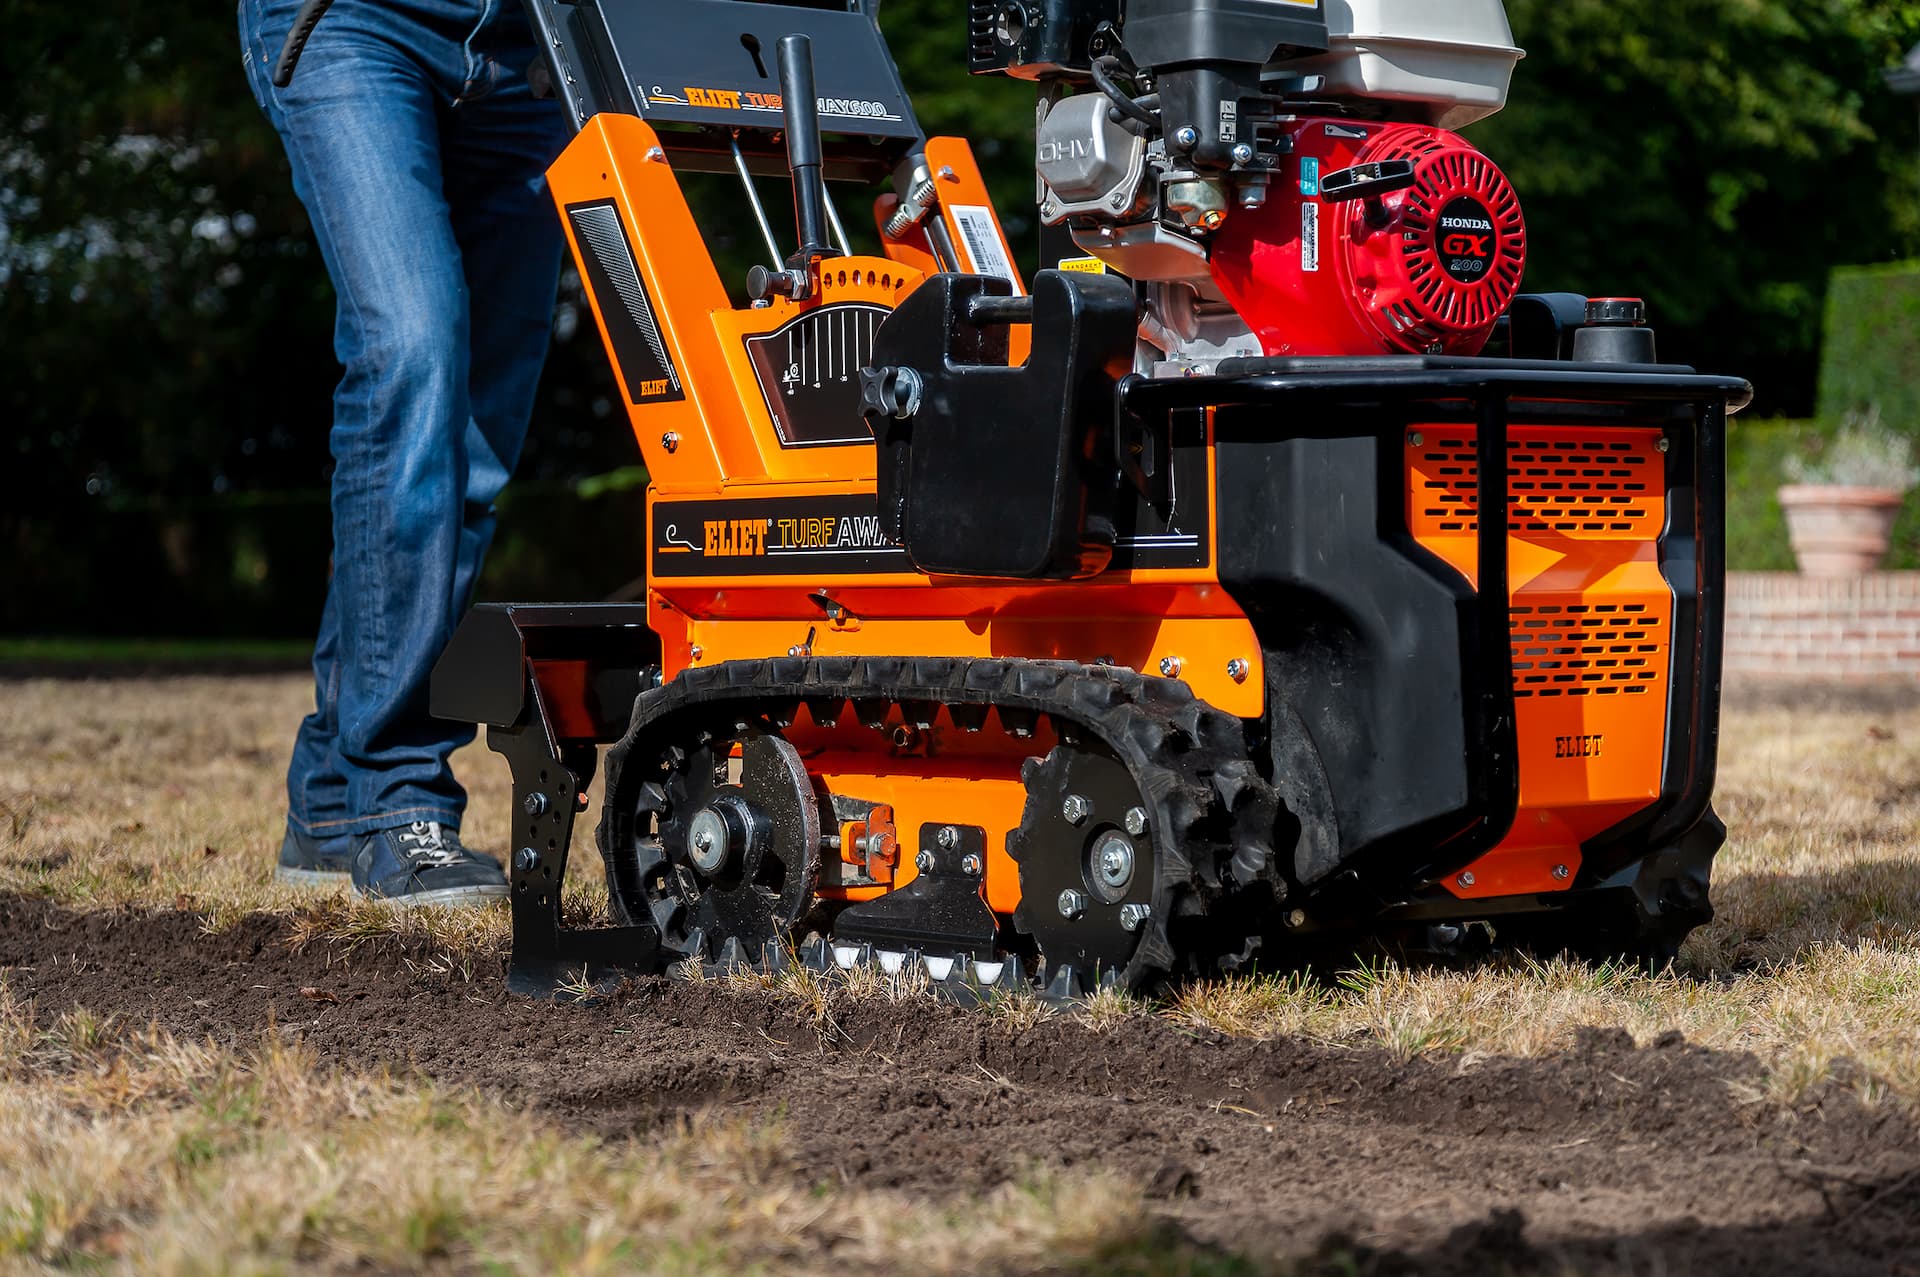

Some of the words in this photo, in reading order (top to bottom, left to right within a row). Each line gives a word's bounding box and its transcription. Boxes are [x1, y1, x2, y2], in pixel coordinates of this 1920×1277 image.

[1039, 138, 1093, 163] OHV
[1441, 217, 1492, 230] HONDA
[1443, 233, 1489, 257] GX
[1450, 258, 1483, 272] 200
[640, 379, 669, 396] ELIET
[1555, 734, 1604, 758] ELIET
